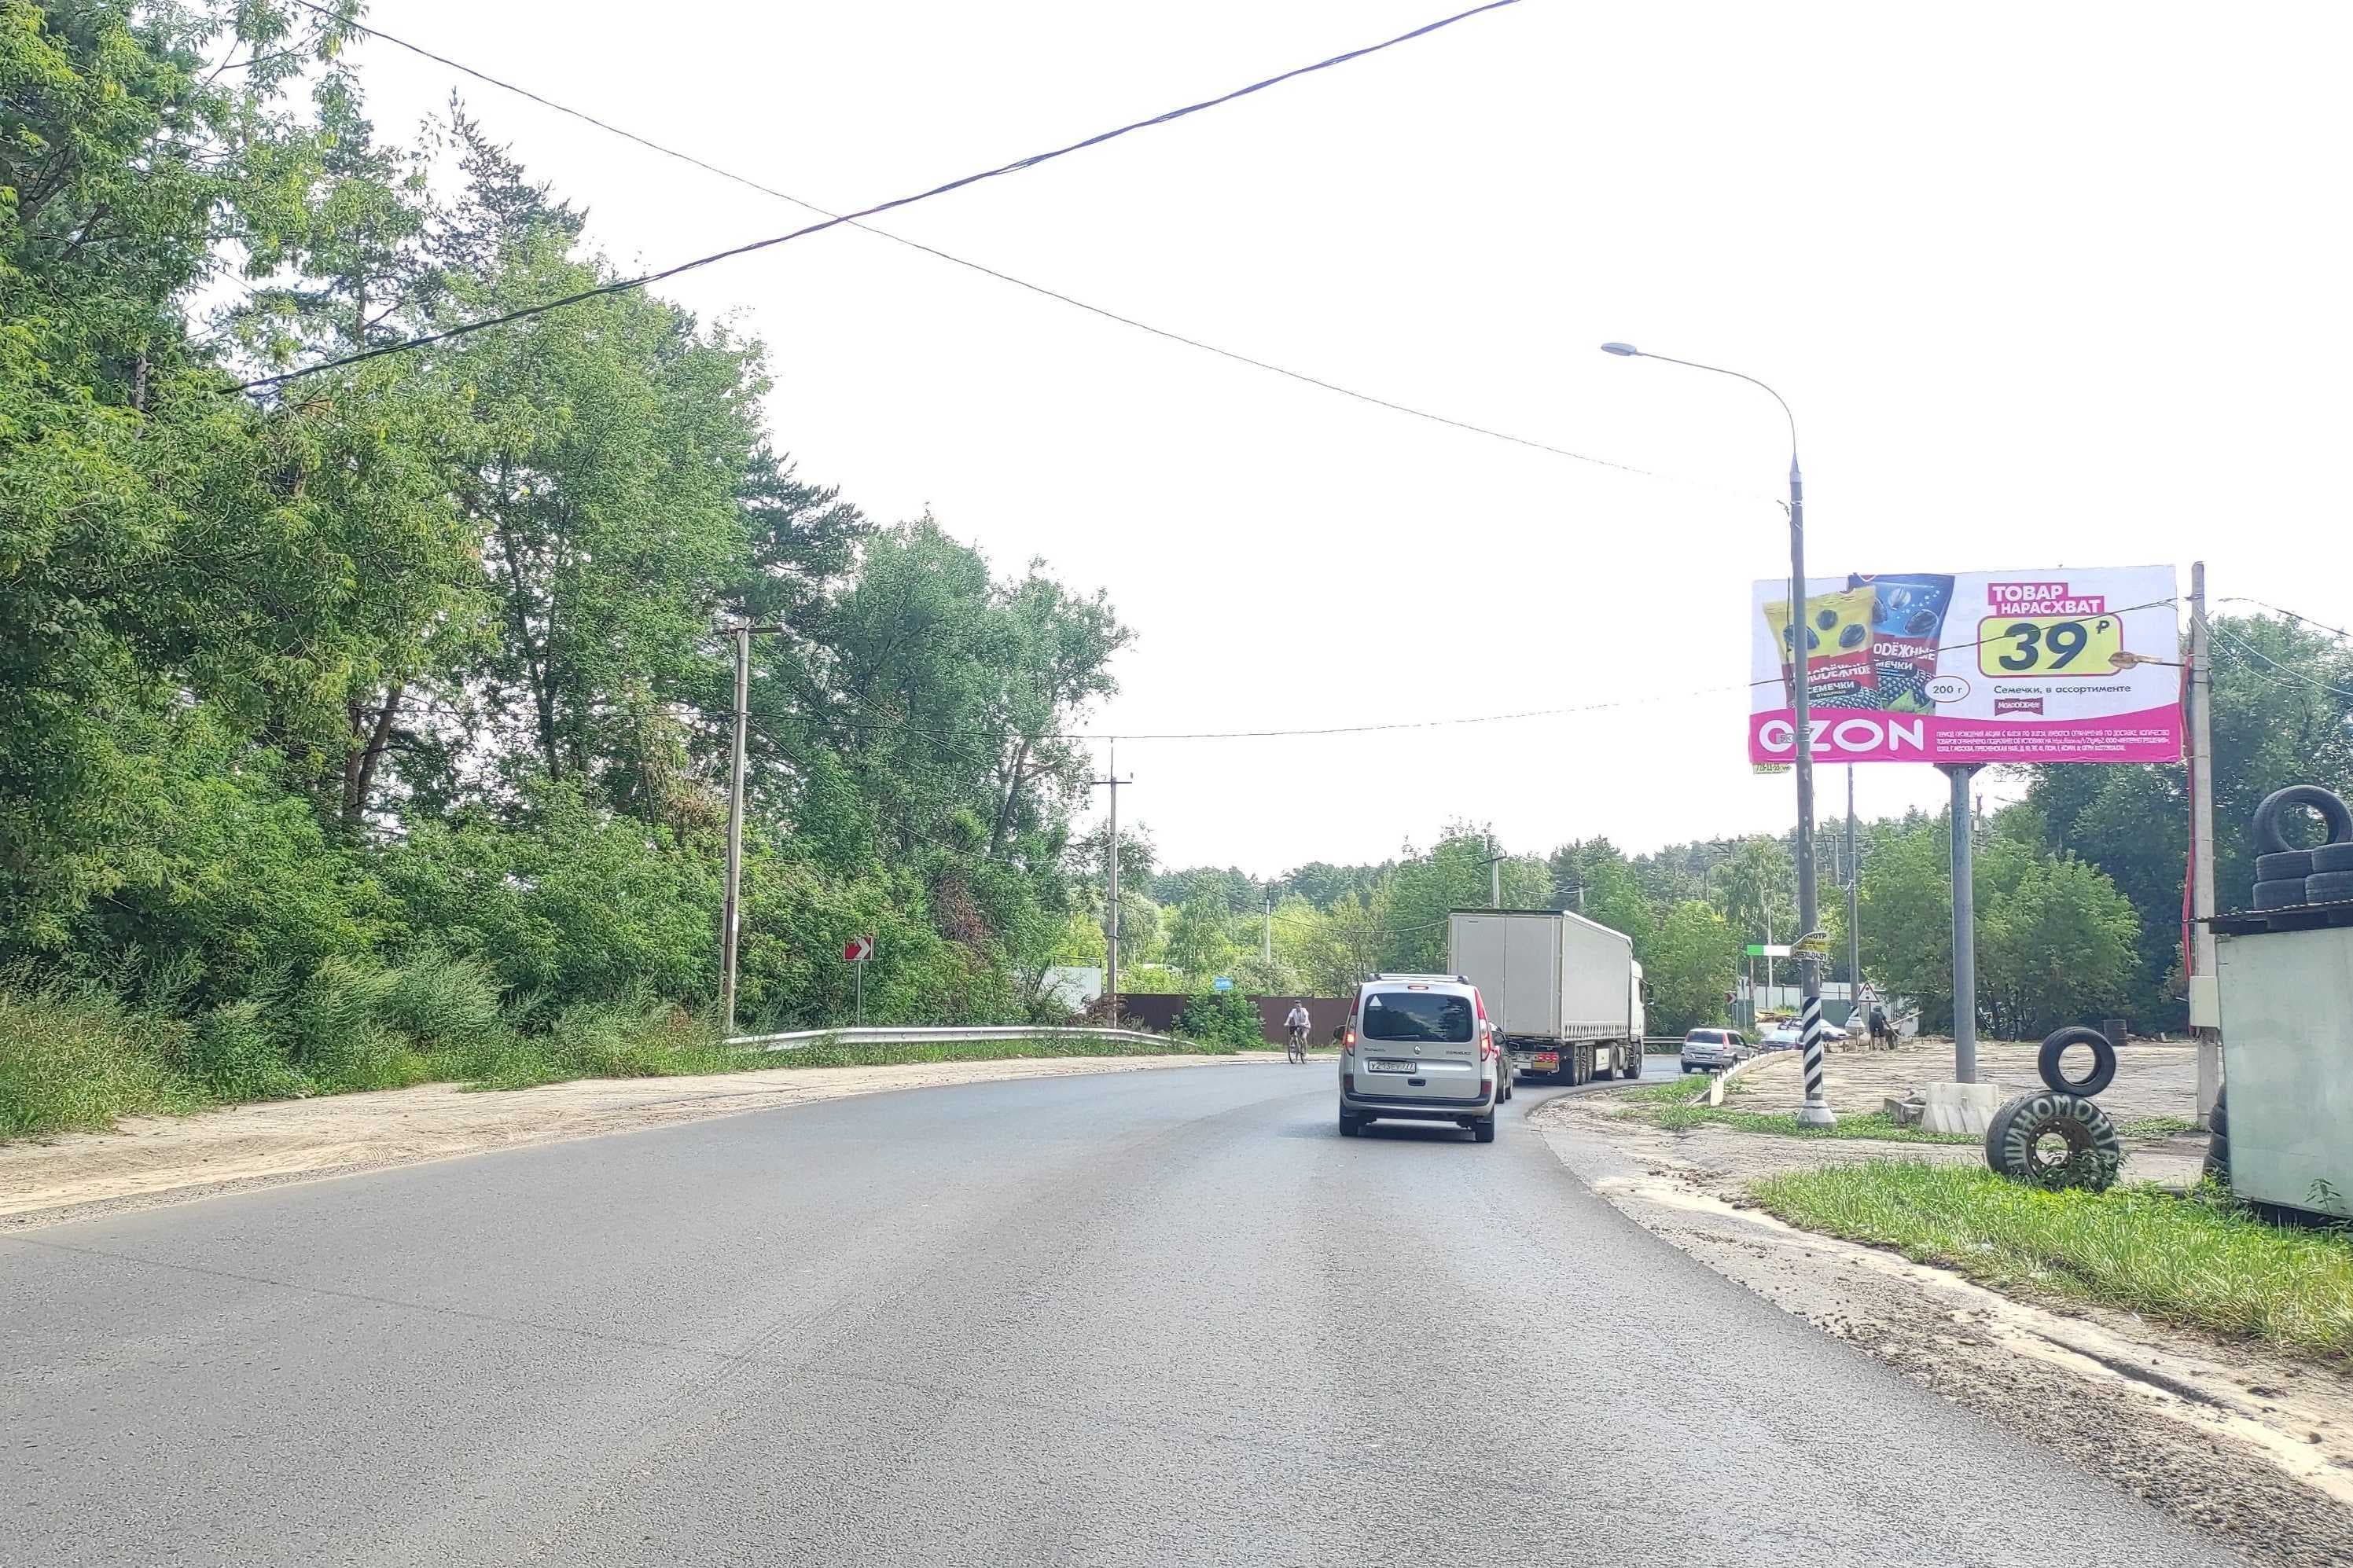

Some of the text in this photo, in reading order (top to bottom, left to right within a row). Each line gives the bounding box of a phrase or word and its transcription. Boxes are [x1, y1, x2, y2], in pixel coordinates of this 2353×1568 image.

[1992, 585, 2063, 601] ТОВАР
[2001, 600, 2101, 615] НАРАСХВАТ
[1873, 642, 1936, 661] ОДЁЖНЫЕ
[1998, 622, 2087, 670] 39
[1933, 685, 1954, 694] 200
[1994, 685, 2042, 694] Семечки,
[2055, 685, 2131, 695] ассортименте
[1759, 718, 1924, 752] OZON
[2004, 1095, 2118, 1171] ШИНОМОНТА
